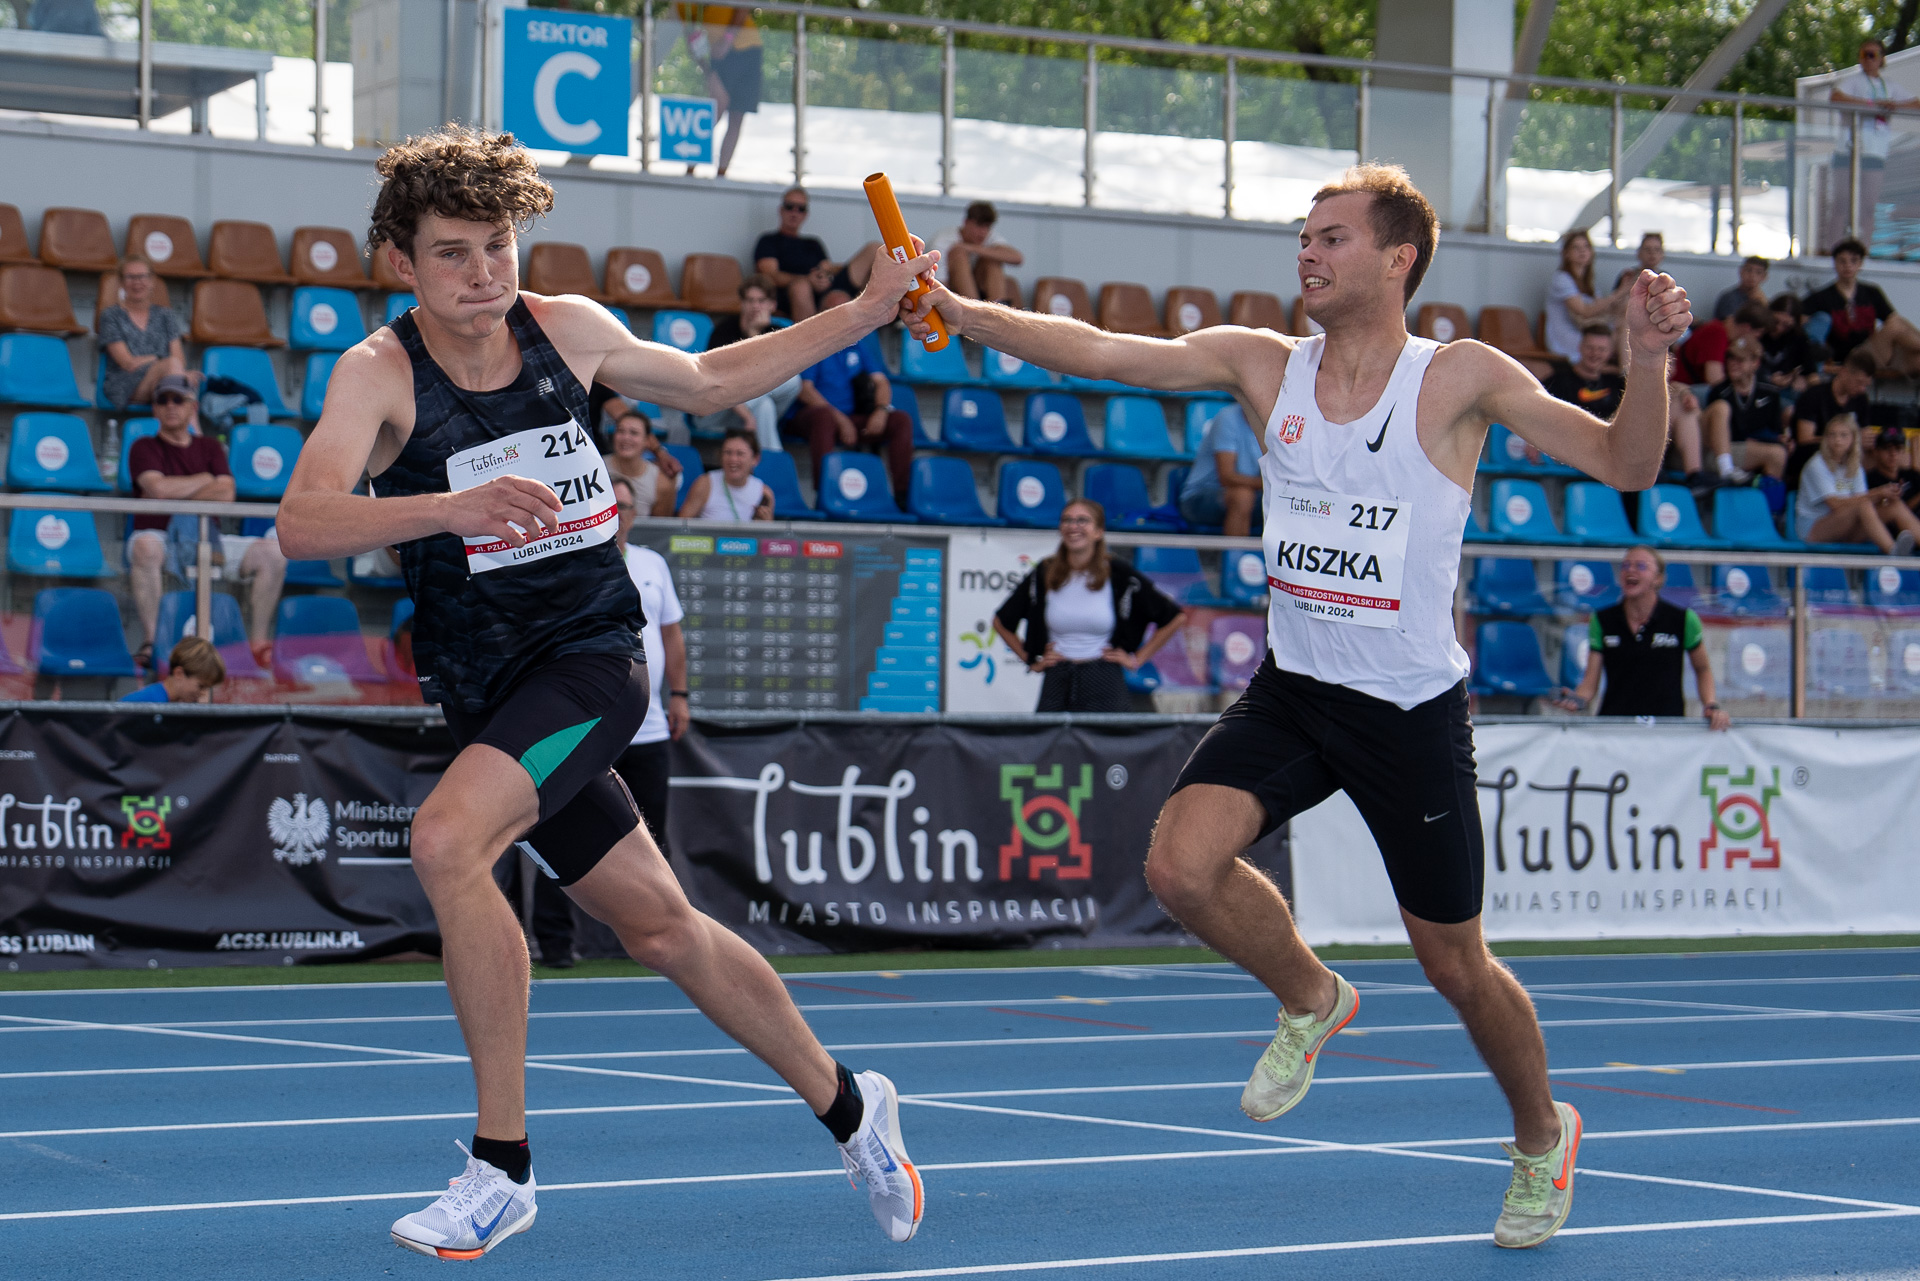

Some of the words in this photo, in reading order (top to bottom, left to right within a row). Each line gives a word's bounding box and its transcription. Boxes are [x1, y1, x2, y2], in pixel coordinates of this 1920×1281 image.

[527, 20, 608, 47] SEKTOR
[533, 51, 602, 146] C
[663, 105, 711, 139] WC
[541, 424, 588, 459] 214
[548, 468, 605, 506] ZIK
[570, 518, 598, 531] POLSKI
[599, 510, 613, 523] U23
[1349, 503, 1398, 531] 217
[474, 545, 486, 553] 41.
[487, 542, 507, 552] PZLA
[513, 540, 552, 560] LUBLIN
[554, 534, 584, 550] 2024
[1277, 540, 1383, 583] KISZKA
[960, 570, 1028, 591] mos
[1292, 587, 1345, 603] MISTRZOSTWA
[1346, 596, 1373, 607] POLSKI
[1375, 599, 1391, 608] U23
[1294, 600, 1325, 613] LUBLIN
[1328, 606, 1354, 618] 2024
[335, 826, 399, 850] Sportu
[402, 827, 410, 847] i
[0, 855, 66, 869] MIASTO
[74, 856, 171, 869] INSPIRACJI
[748, 901, 887, 926] MIASTO
[907, 898, 1096, 925] INSPIRACJI
[1492, 890, 1600, 912] MIASTO
[1621, 887, 1782, 911] INSPIRACJI
[26, 934, 95, 953] LUBLIN
[216, 930, 365, 949] ACSS.LUBLIN.PL
